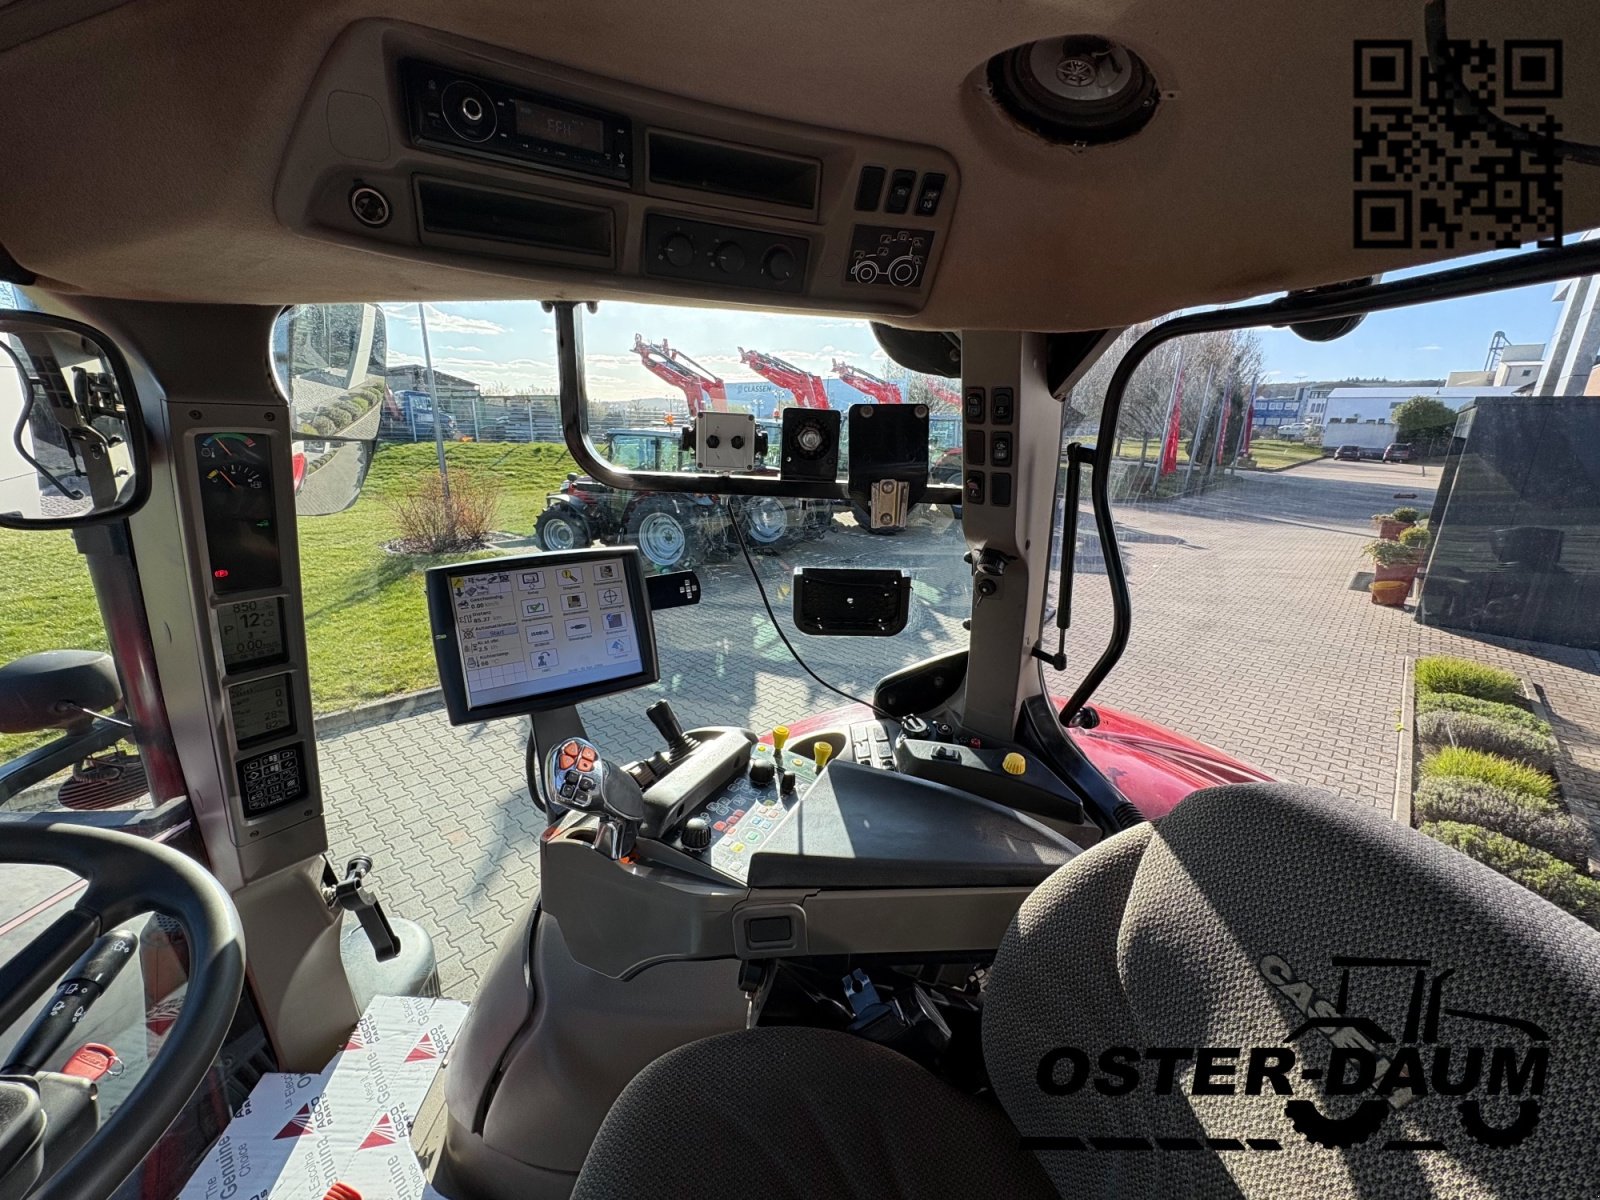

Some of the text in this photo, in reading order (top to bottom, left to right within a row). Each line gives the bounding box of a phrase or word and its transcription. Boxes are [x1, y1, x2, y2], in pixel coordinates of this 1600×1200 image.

[743, 384, 772, 393] CLASSEN
[233, 600, 257, 614] 850
[240, 612, 261, 629] 12
[224, 624, 234, 636] P
[360, 1018, 375, 1044] AGCO
[367, 1014, 380, 1042] PARTS
[430, 1027, 447, 1054] AGCO
[284, 1098, 293, 1110] La
[310, 1096, 327, 1129] AGCO
[320, 1092, 334, 1126] PARTS
[390, 1106, 408, 1138] AGCO
[216, 1136, 238, 1199] Genuine
[238, 1143, 251, 1178] Choice
[304, 1152, 321, 1192] Escolha
[316, 1135, 339, 1187] enuína
[205, 1176, 218, 1200] The
